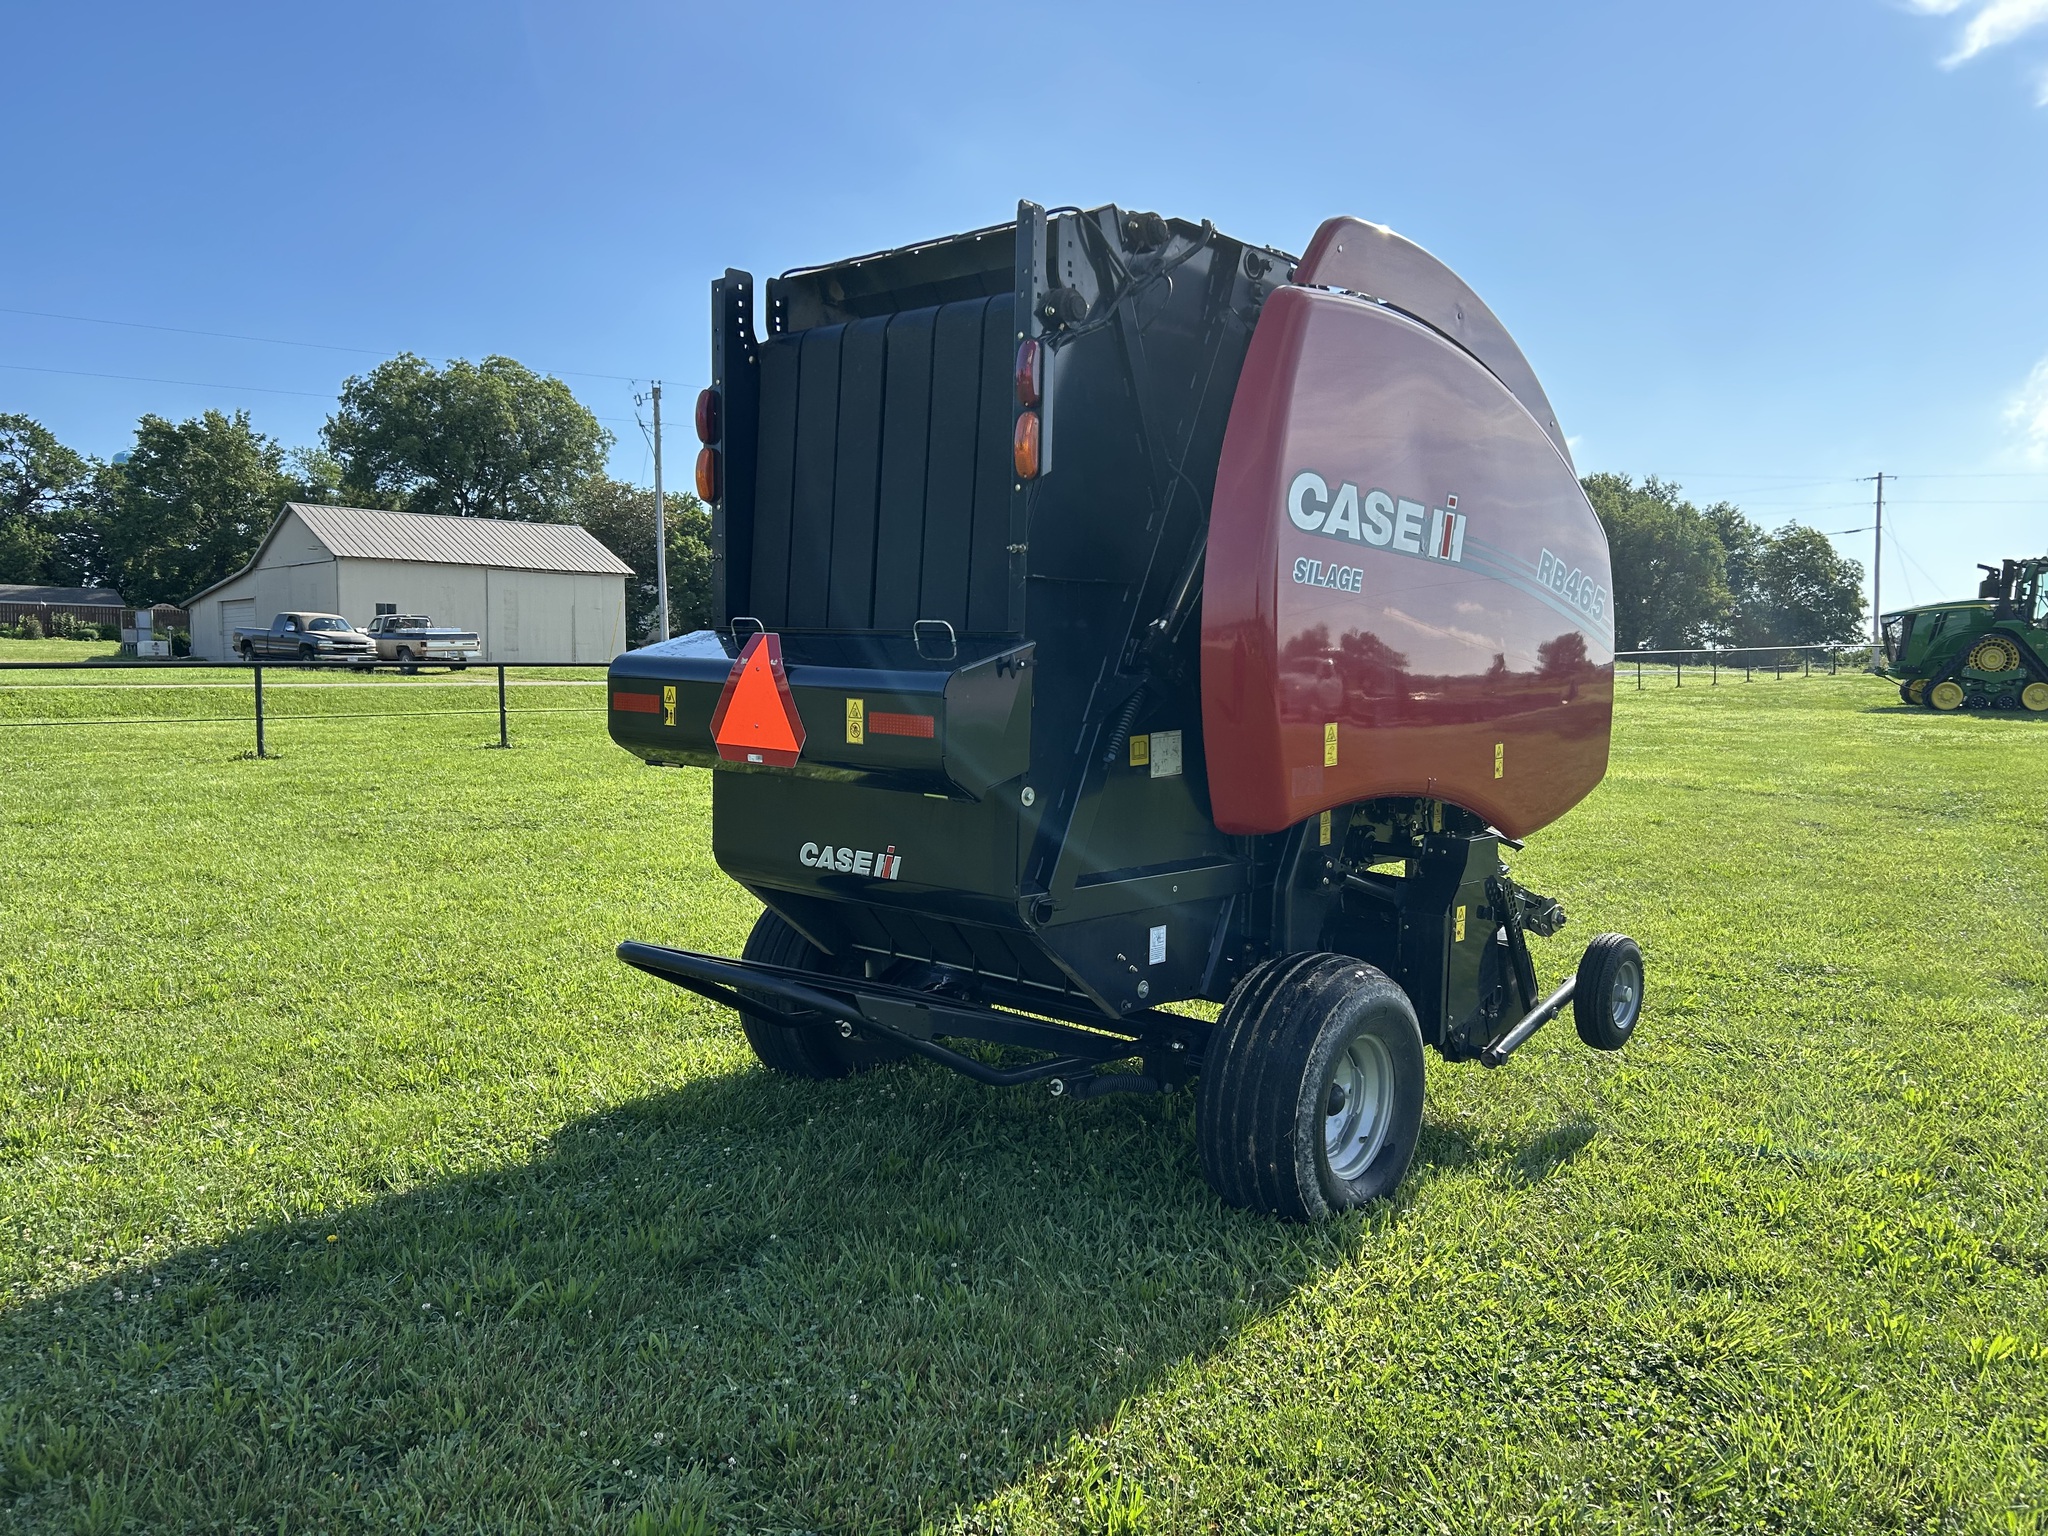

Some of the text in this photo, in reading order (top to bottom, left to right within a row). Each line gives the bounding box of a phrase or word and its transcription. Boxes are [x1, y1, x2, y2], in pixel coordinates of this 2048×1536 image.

[1287, 471, 1426, 554] CASE
[1292, 557, 1364, 594] SILAGE
[1535, 548, 1608, 623] RB465
[799, 841, 873, 876] CASE
